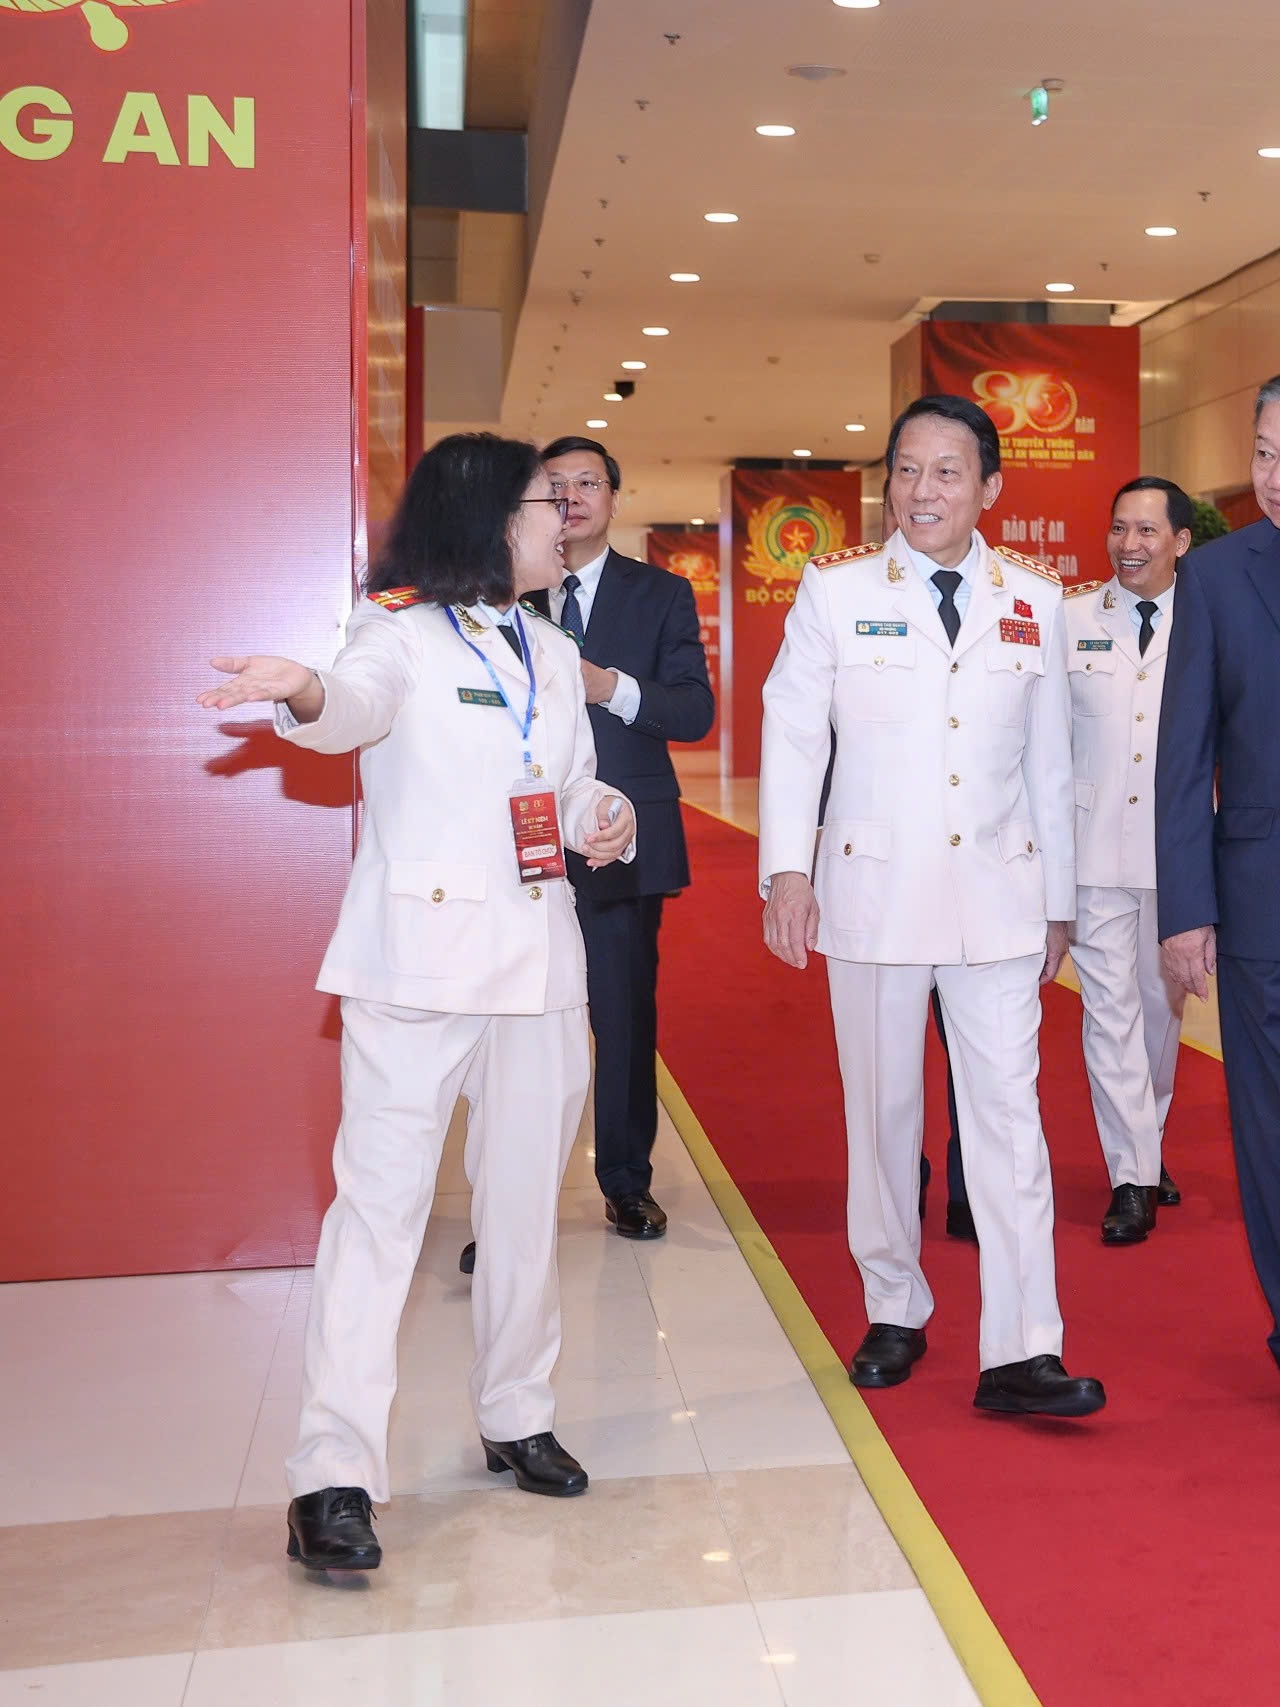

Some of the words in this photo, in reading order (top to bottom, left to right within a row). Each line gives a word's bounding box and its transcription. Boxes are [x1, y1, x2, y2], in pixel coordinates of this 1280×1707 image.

[102, 91, 256, 168] AN
[1048, 520, 1065, 543] AN
[745, 586, 770, 607] BỘ
